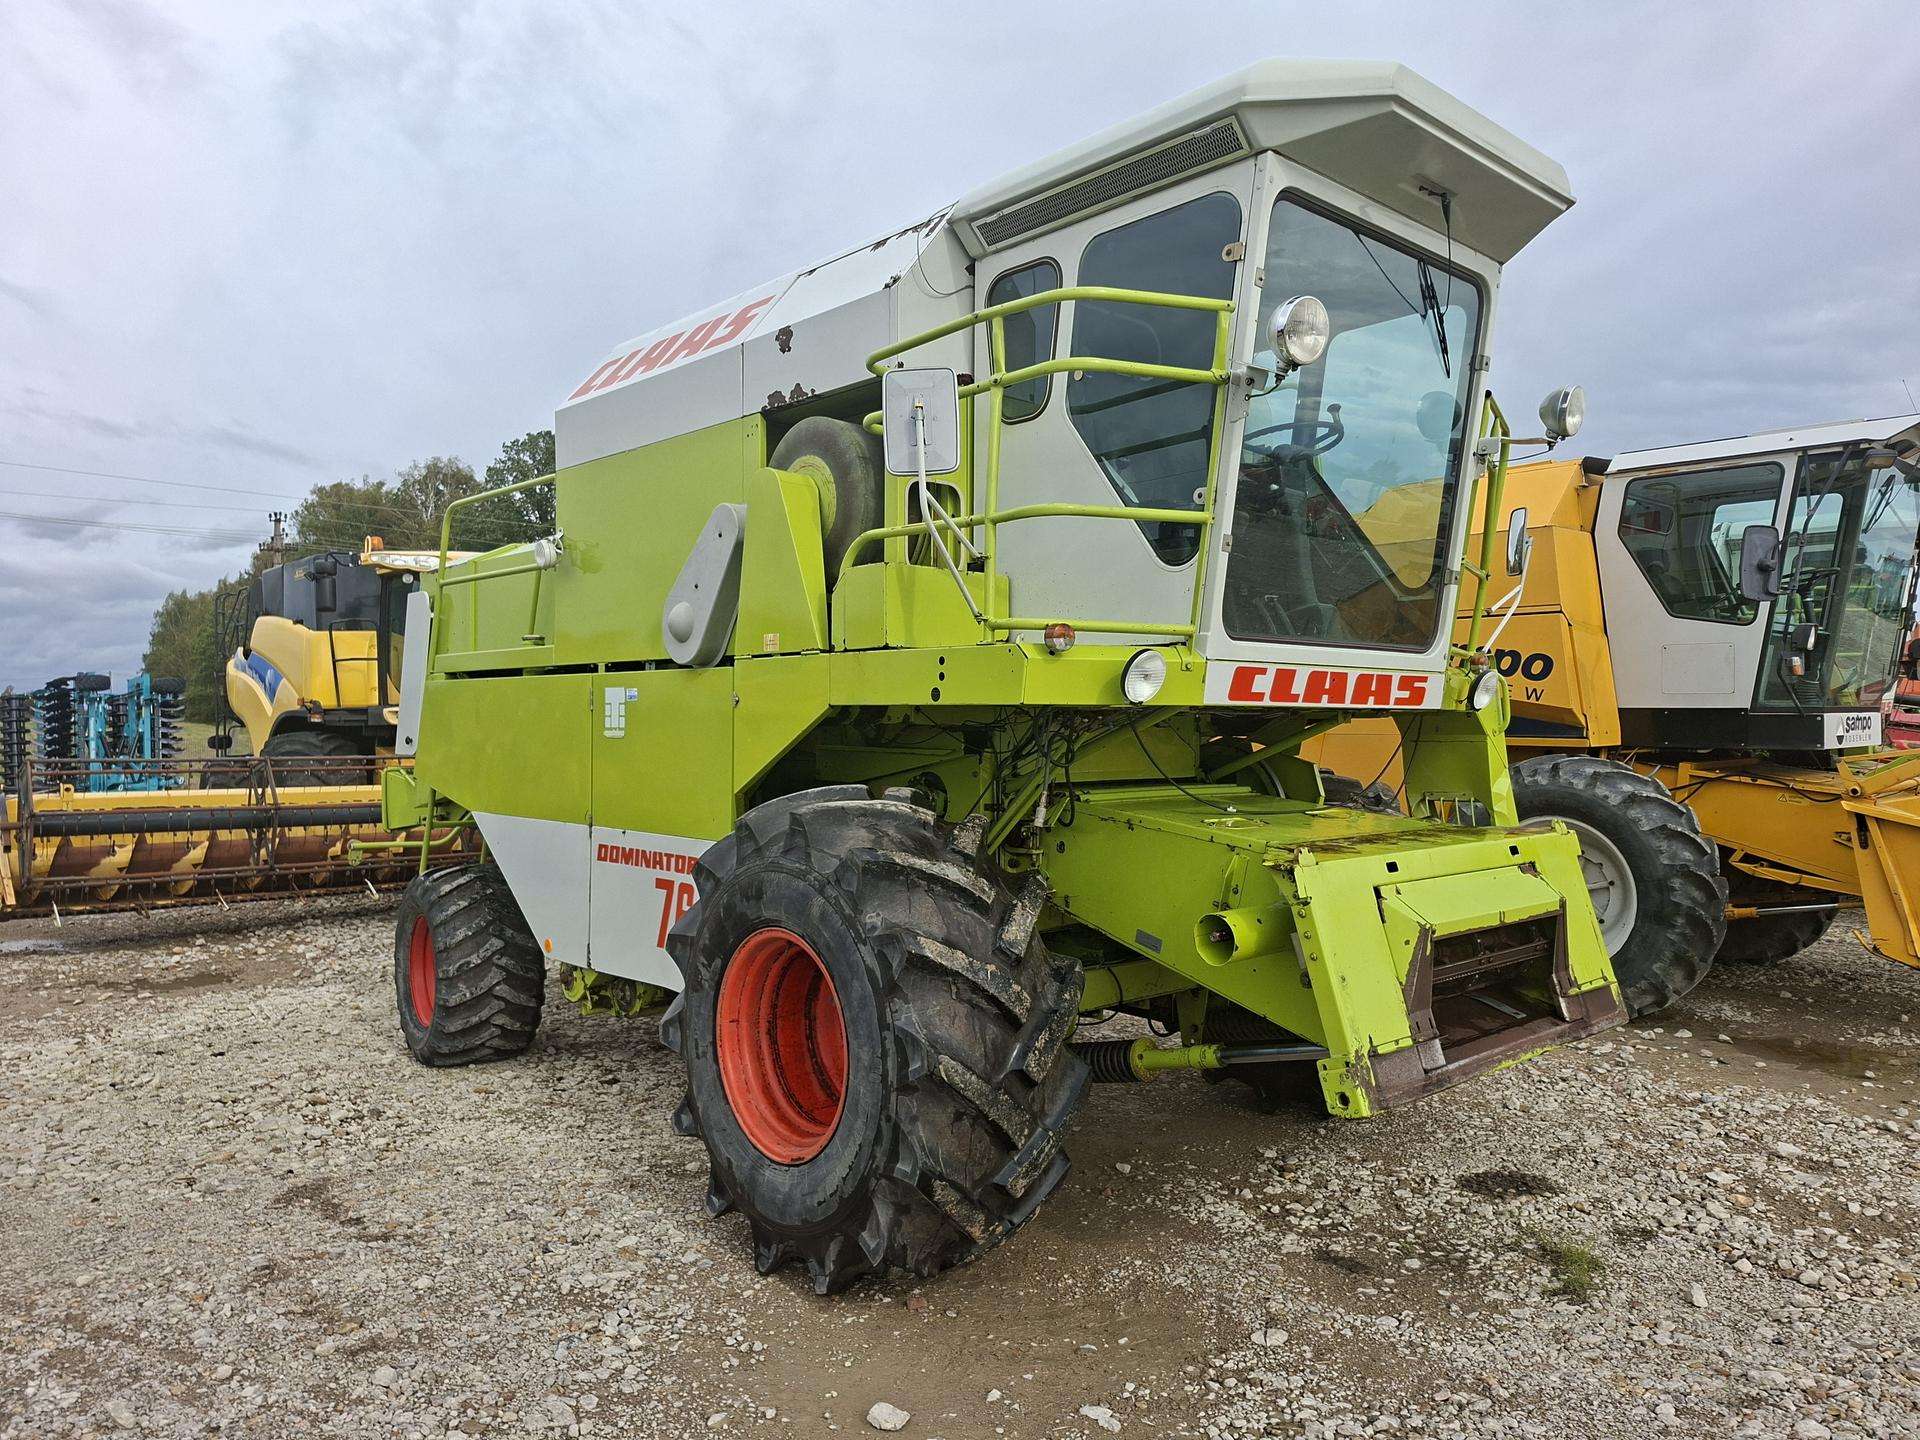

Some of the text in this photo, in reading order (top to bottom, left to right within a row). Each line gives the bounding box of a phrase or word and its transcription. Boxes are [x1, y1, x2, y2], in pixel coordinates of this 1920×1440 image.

[568, 295, 776, 401] CLAAS
[1227, 666, 1429, 706] CLAAS
[1845, 715, 1872, 734] sampo
